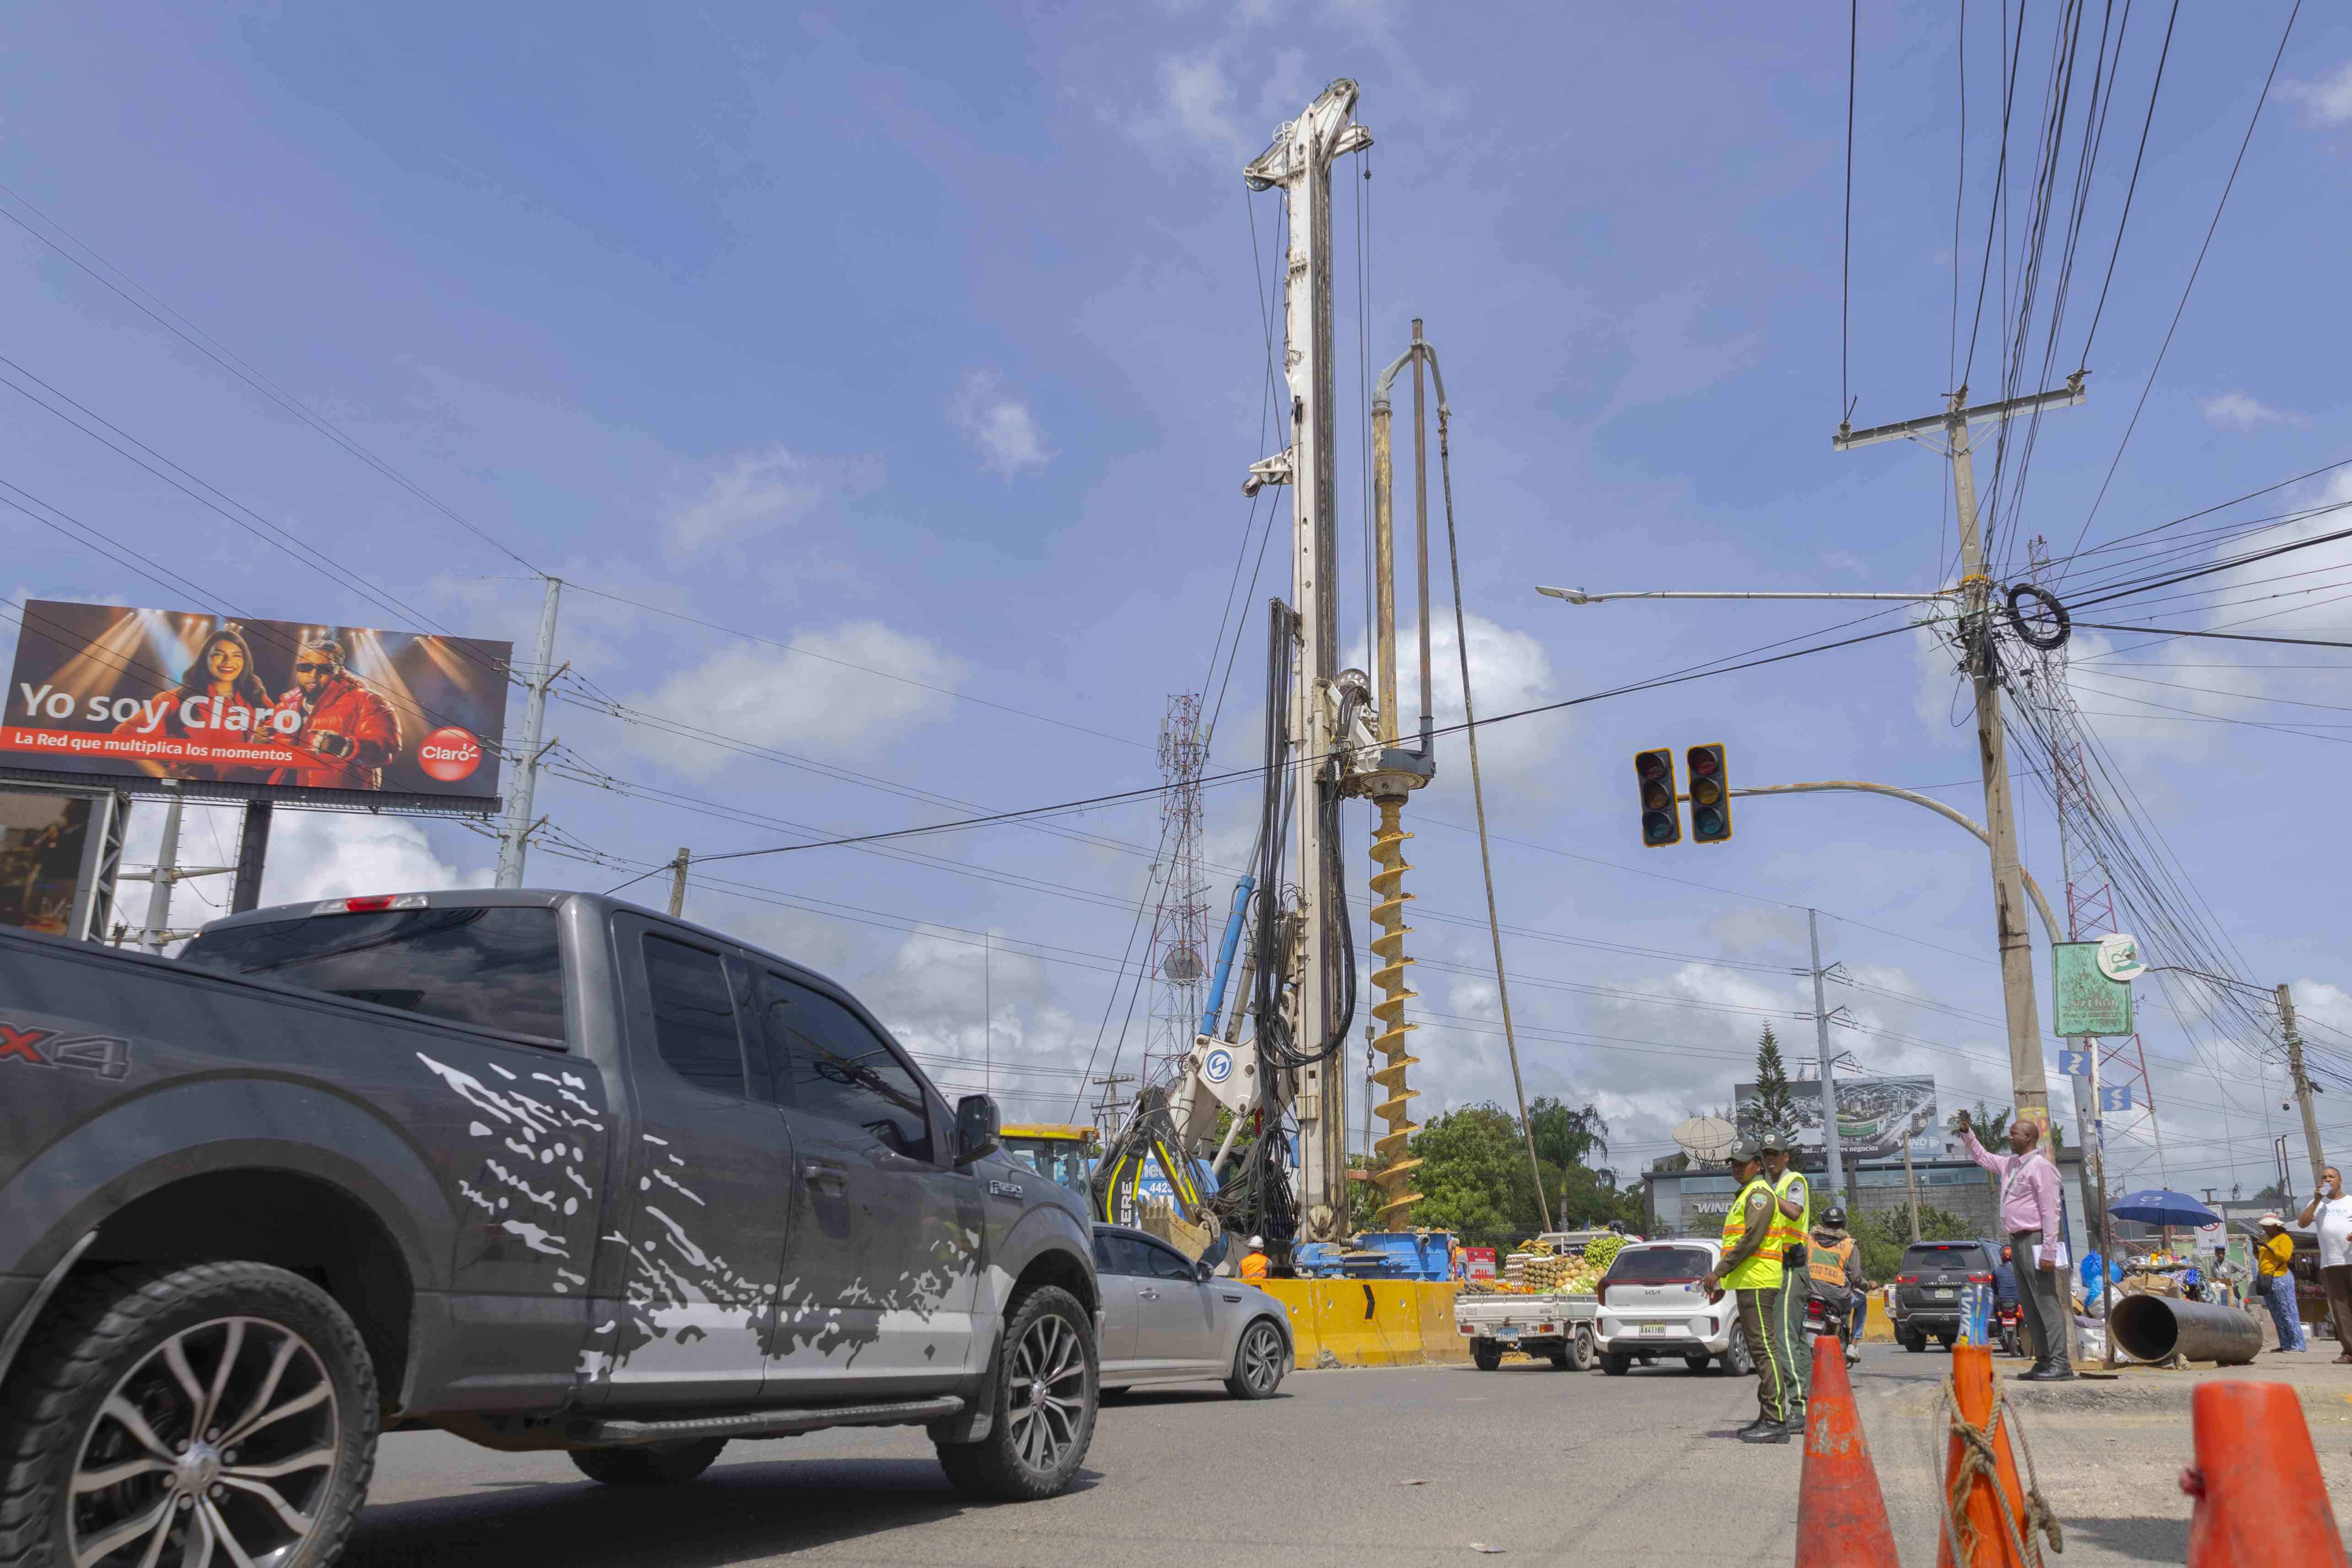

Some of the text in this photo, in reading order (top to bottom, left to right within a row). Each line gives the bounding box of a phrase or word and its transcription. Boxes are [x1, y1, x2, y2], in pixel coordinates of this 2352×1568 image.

[20, 683, 302, 734] Yo soy Claro
[15, 732, 293, 761] La Red que multiplica los momentos
[422, 745, 470, 761] Claro
[1824, 1267, 1838, 1278] TAXI
